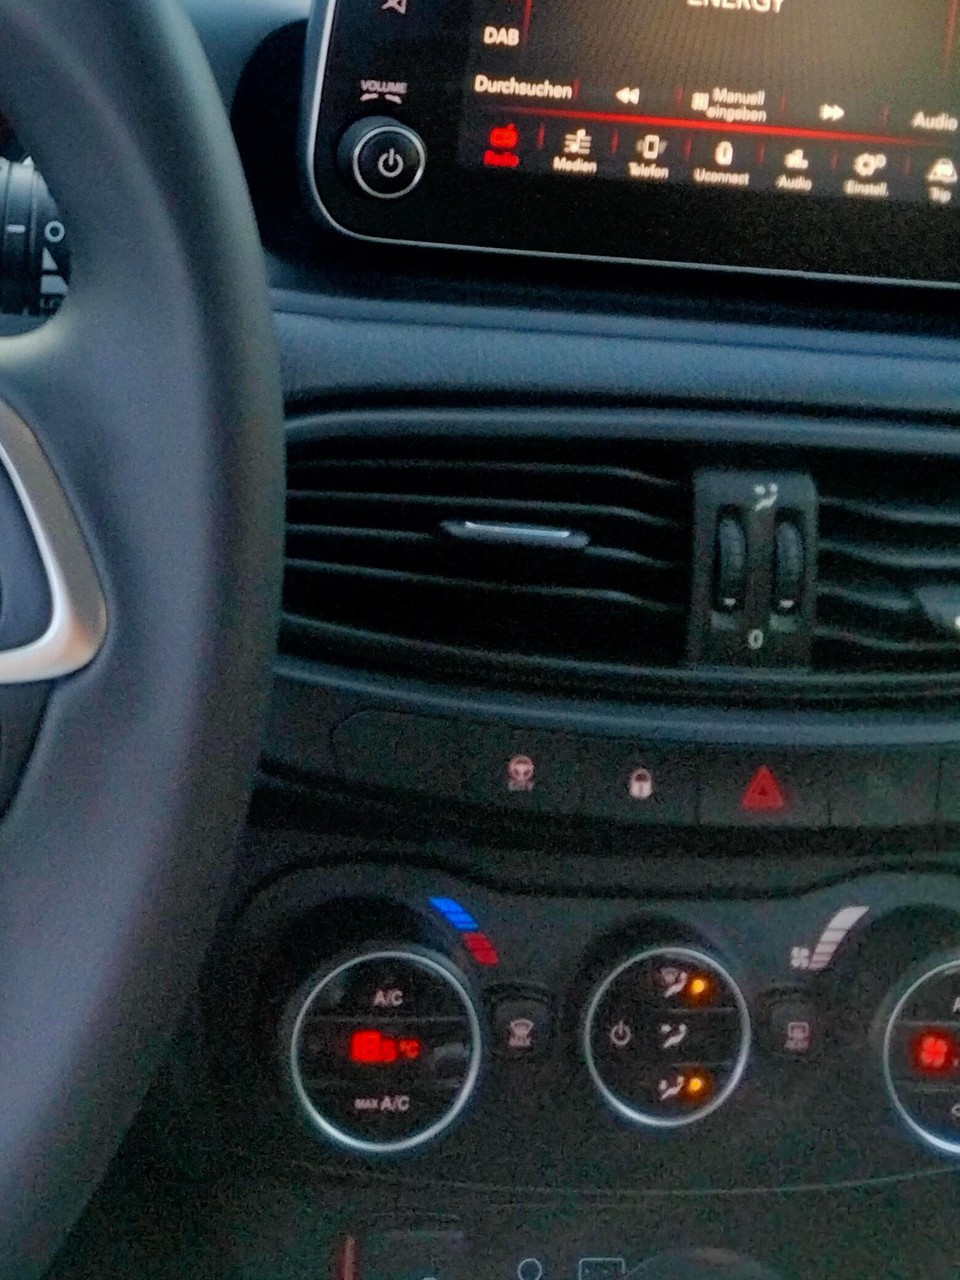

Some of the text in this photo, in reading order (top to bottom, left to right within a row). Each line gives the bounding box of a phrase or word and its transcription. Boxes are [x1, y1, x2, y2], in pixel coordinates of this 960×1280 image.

[483, 26, 520, 47] DAB
[360, 79, 407, 94] VOLUME
[474, 74, 573, 100] Durchsuchen
[712, 87, 766, 107] Manuell
[705, 104, 767, 123] eingeben
[911, 110, 958, 132] Audio
[552, 156, 597, 174] Medien
[628, 161, 669, 180] Telefon
[775, 174, 813, 192] Audio
[373, 989, 404, 1007] A/C
[380, 1095, 410, 1112] A/C
